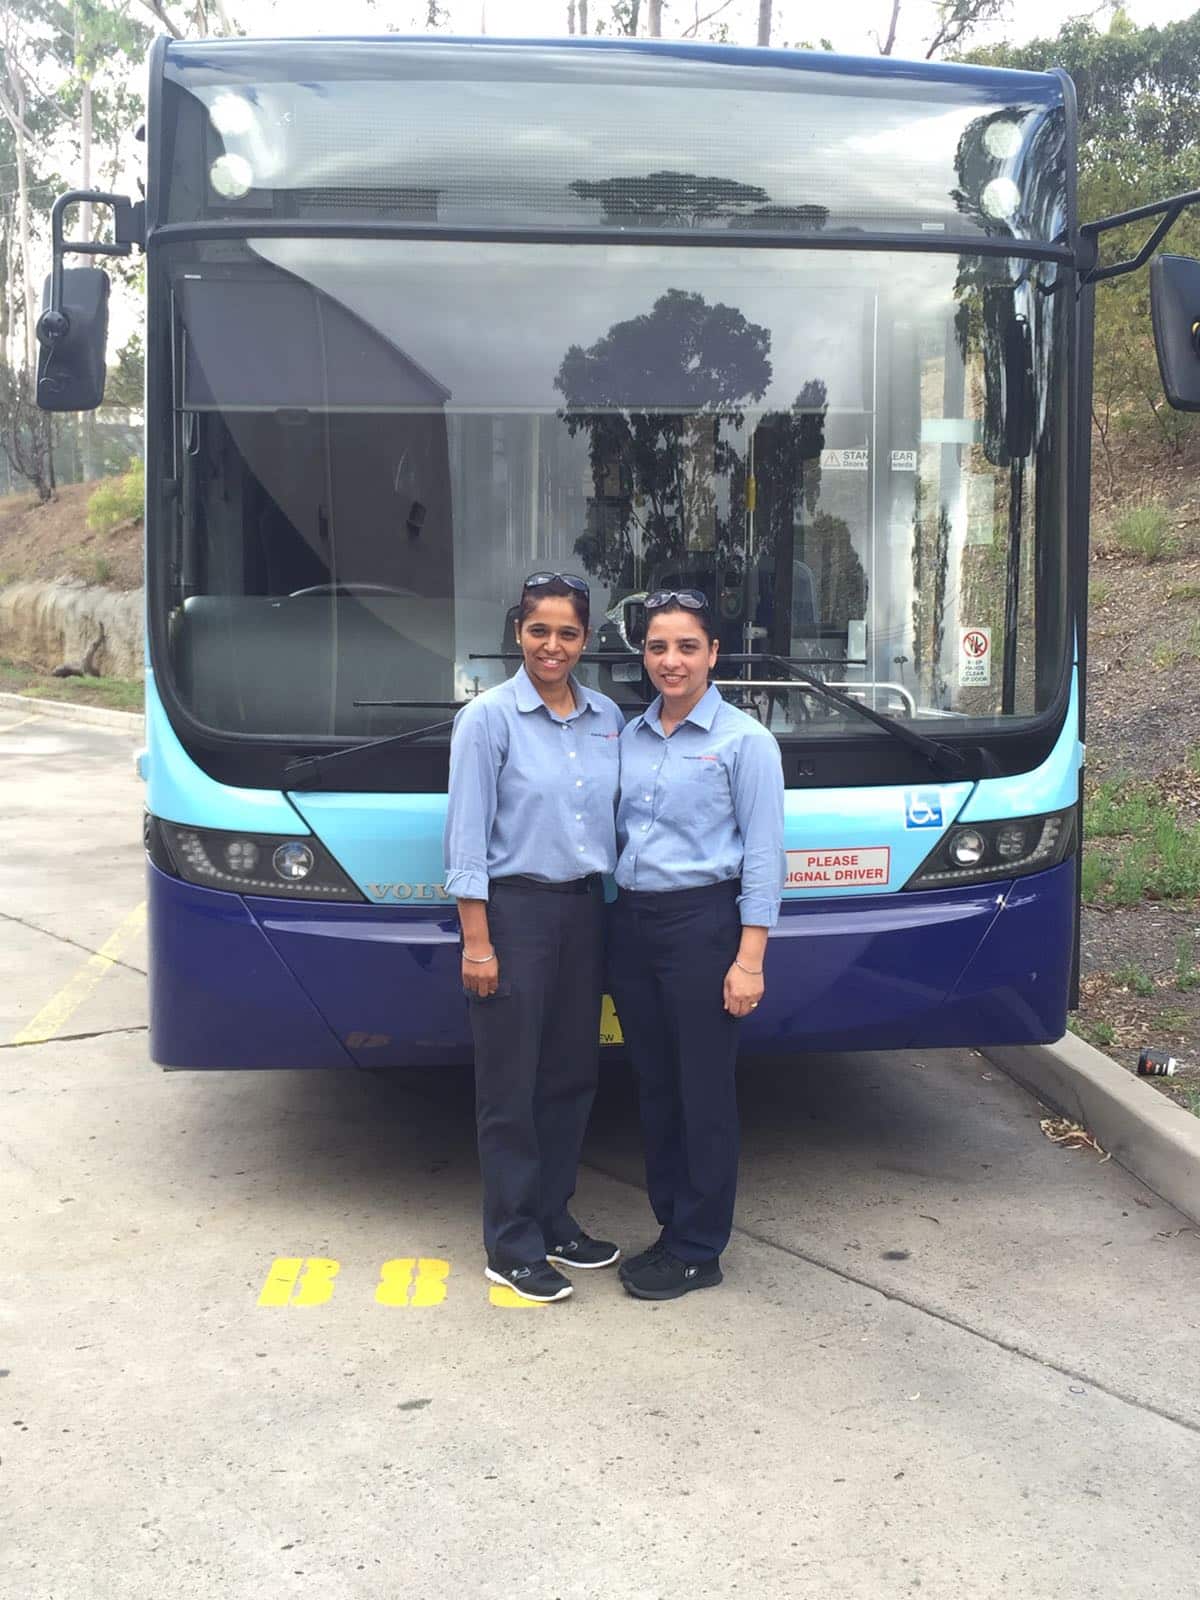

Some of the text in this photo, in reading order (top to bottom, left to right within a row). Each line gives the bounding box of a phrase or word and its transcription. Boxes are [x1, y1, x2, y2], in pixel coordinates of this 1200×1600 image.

[843, 451, 913, 461] STAN EAR
[807, 855, 859, 867] PLEASE
[785, 868, 884, 883] IGNAL DRIVER
[367, 882, 449, 899] VOLV
